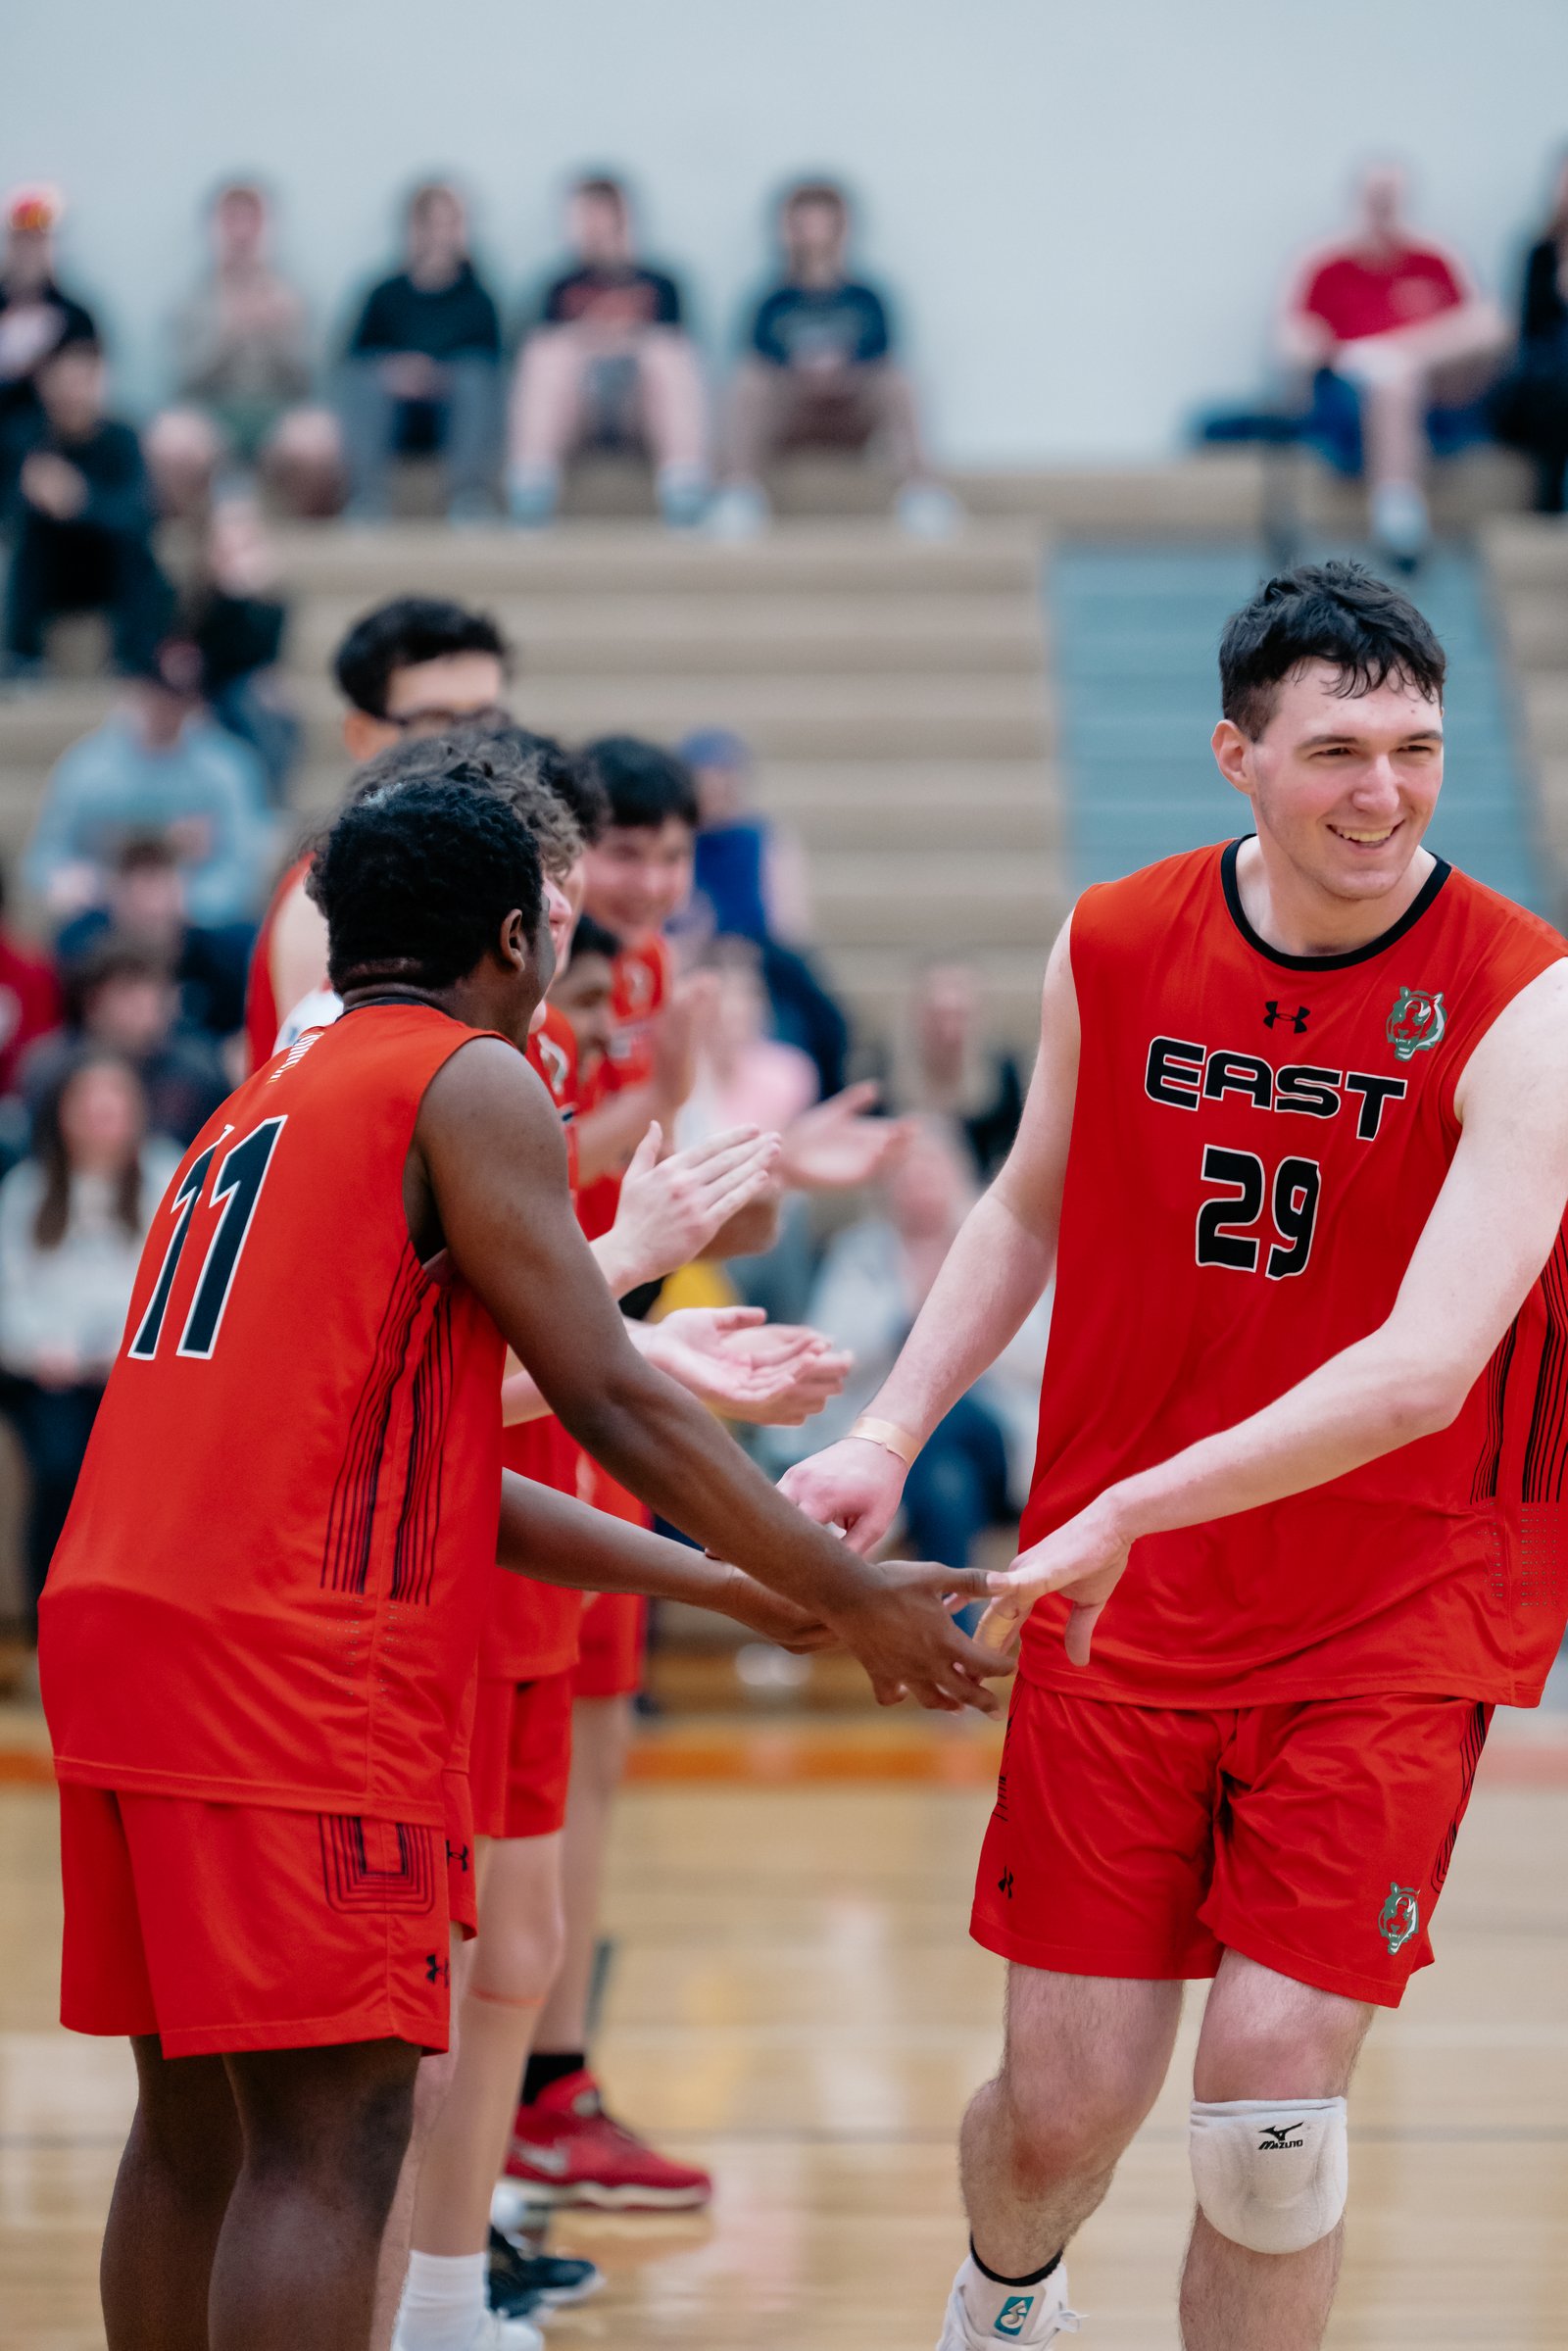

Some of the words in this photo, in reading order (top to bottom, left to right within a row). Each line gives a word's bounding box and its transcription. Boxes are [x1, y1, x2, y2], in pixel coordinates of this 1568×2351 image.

[1144, 1035, 1408, 1141] EAST
[126, 1114, 289, 1360] 11
[1195, 1144, 1321, 1281] 29
